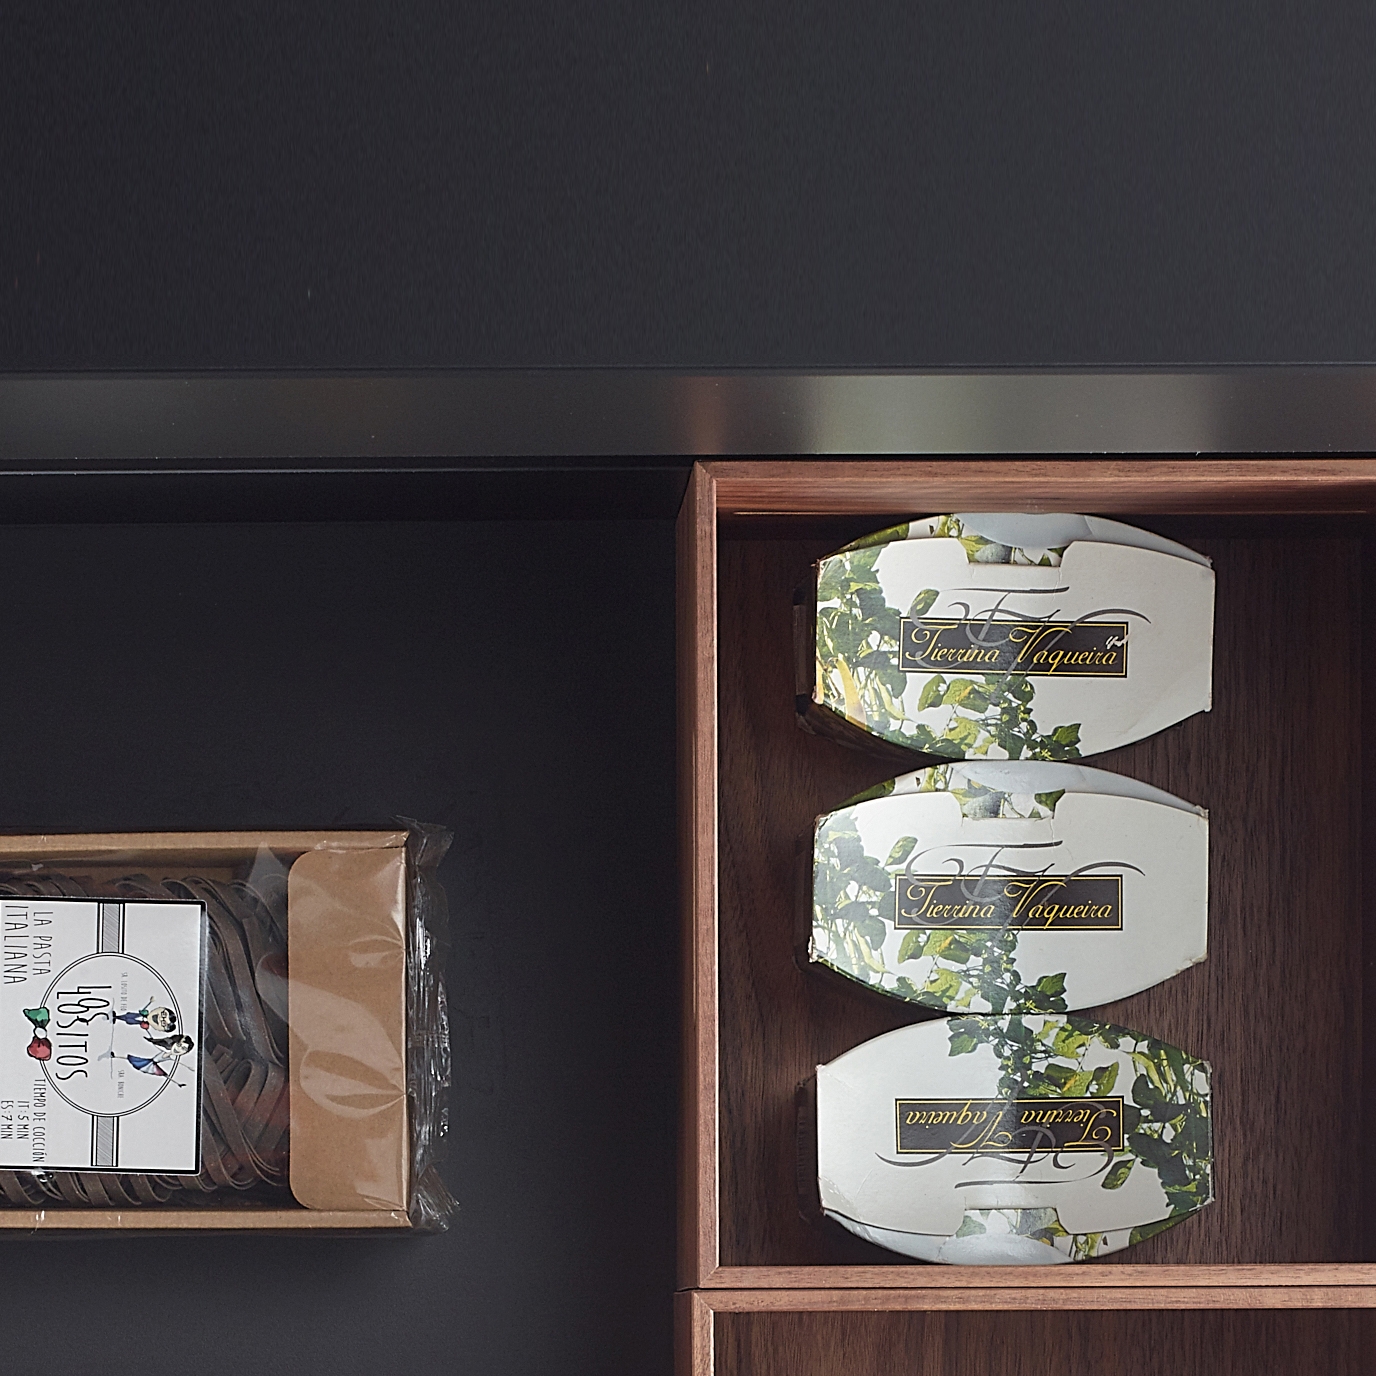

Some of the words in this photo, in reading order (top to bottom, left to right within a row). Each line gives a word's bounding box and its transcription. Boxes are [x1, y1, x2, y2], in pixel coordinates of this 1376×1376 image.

[905, 624, 1000, 663] Tierrina
[1009, 627, 1119, 675] Vaqueira
[33, 911, 53, 926] LA
[901, 881, 995, 919] Tierrina
[1004, 881, 1113, 929] Vaqueira
[3, 905, 29, 984] ITALIANA
[32, 935, 53, 976] PASTA
[77, 985, 112, 1021] LOS
[55, 991, 92, 1080] LOSITOS
[33, 1078, 46, 1108] TIEMPO
[0, 1123, 13, 1140] MIN
[16, 1123, 29, 1140] MIN
[33, 1111, 46, 1122] DE
[905, 1099, 1012, 1149] Vaqueira
[1020, 1108, 1118, 1148] Tierrina
[31, 1126, 48, 1163] COCCIÓN
